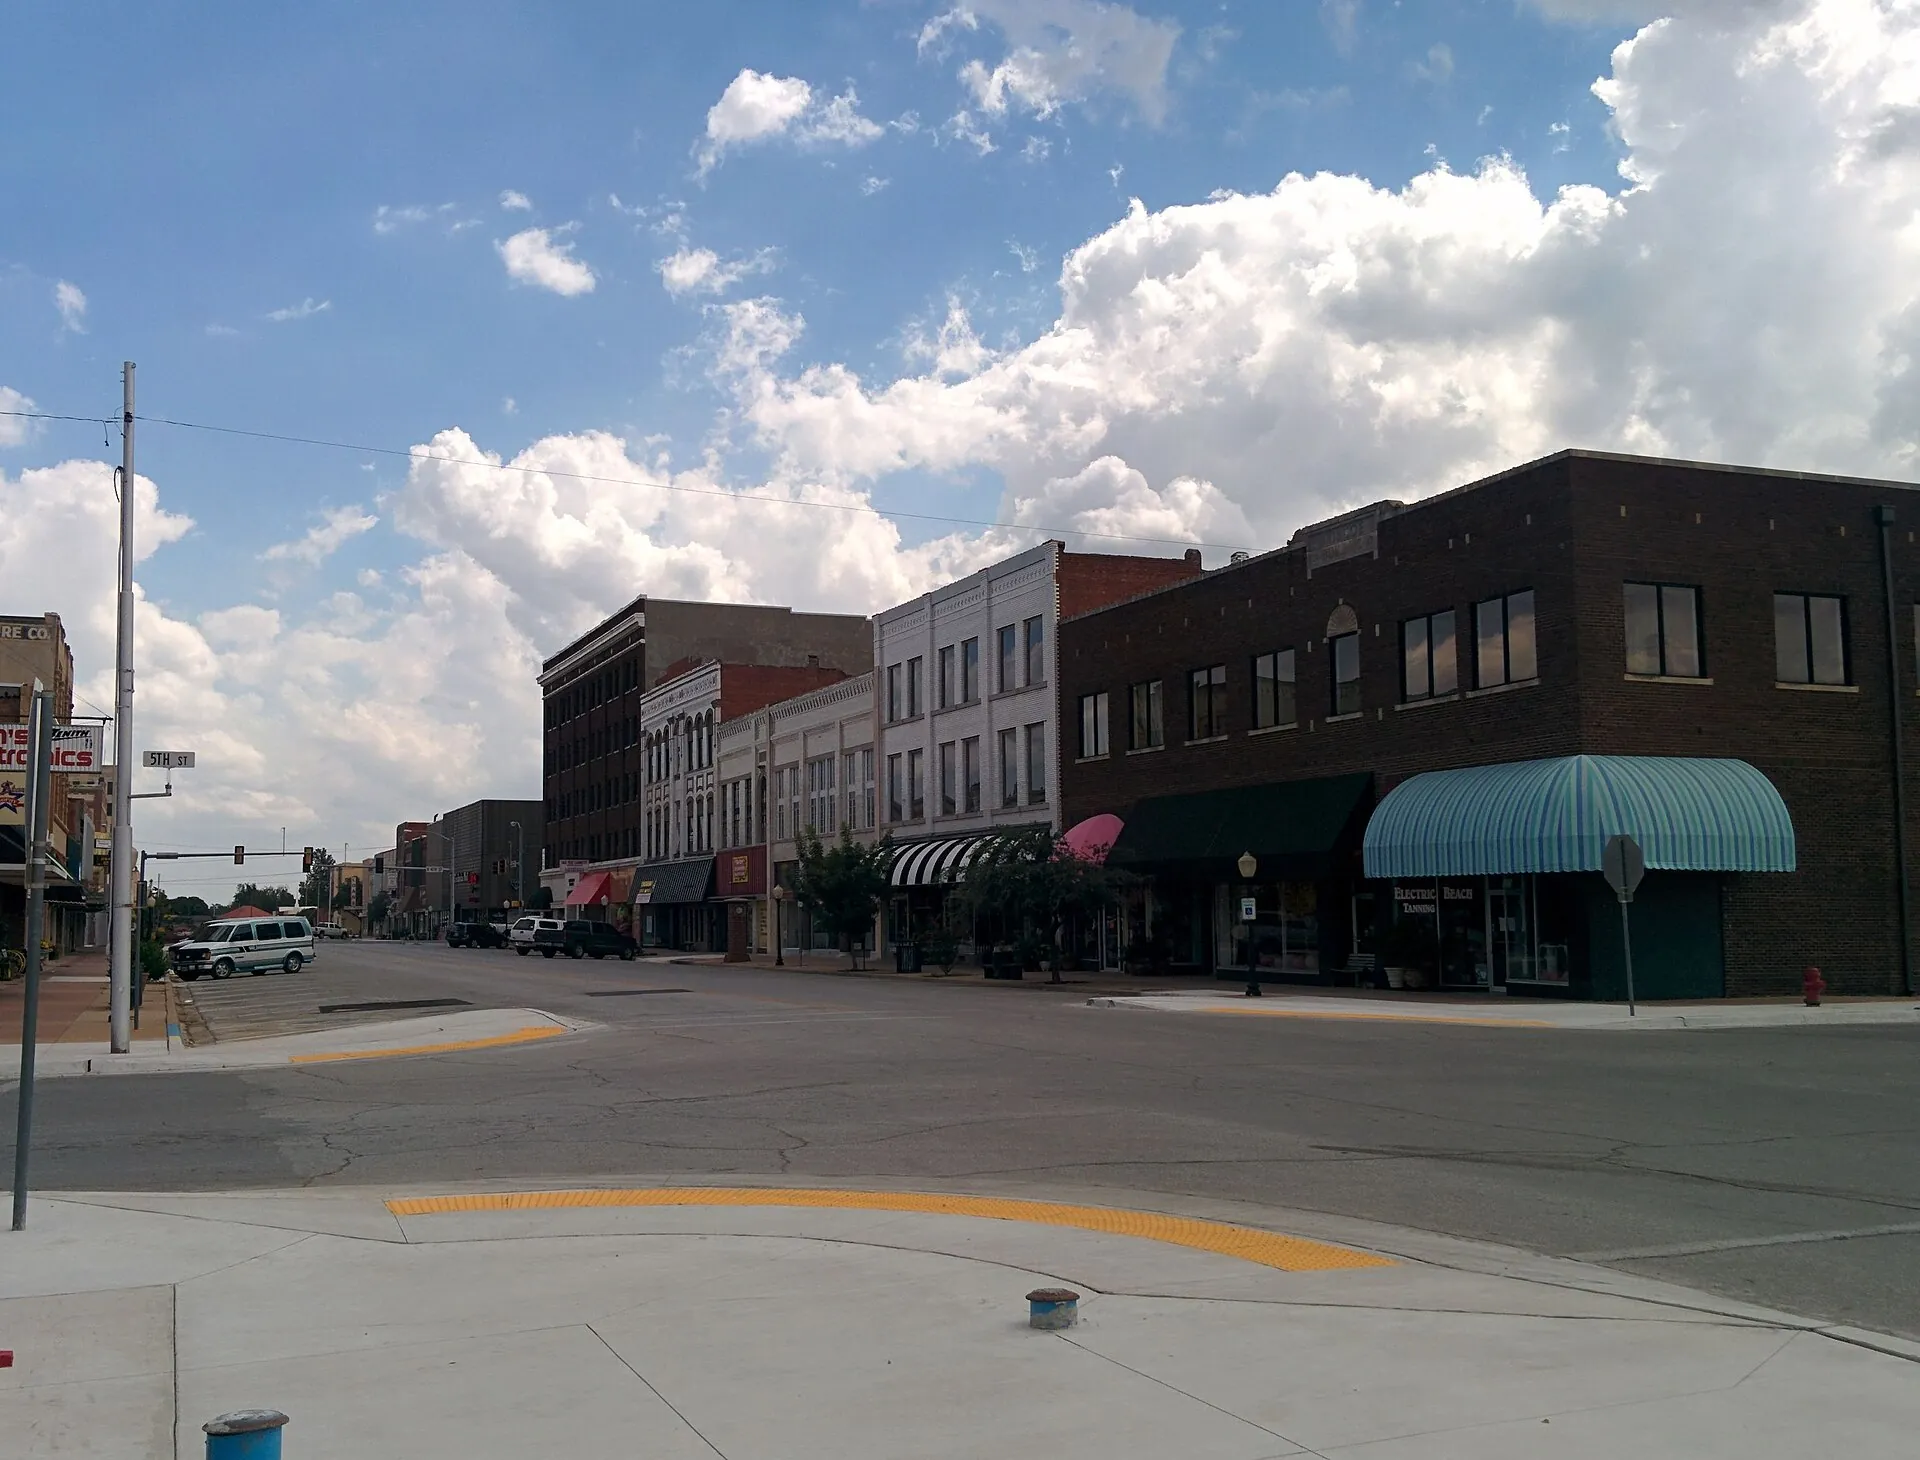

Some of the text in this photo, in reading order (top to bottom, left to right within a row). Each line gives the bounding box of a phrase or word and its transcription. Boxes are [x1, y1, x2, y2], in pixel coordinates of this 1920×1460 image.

[0, 747, 93, 767] troics
[150, 752, 188, 766] 5TH ST
[1393, 886, 1473, 900] ELECTRIC BEACH
[1402, 903, 1435, 913] TANNING
